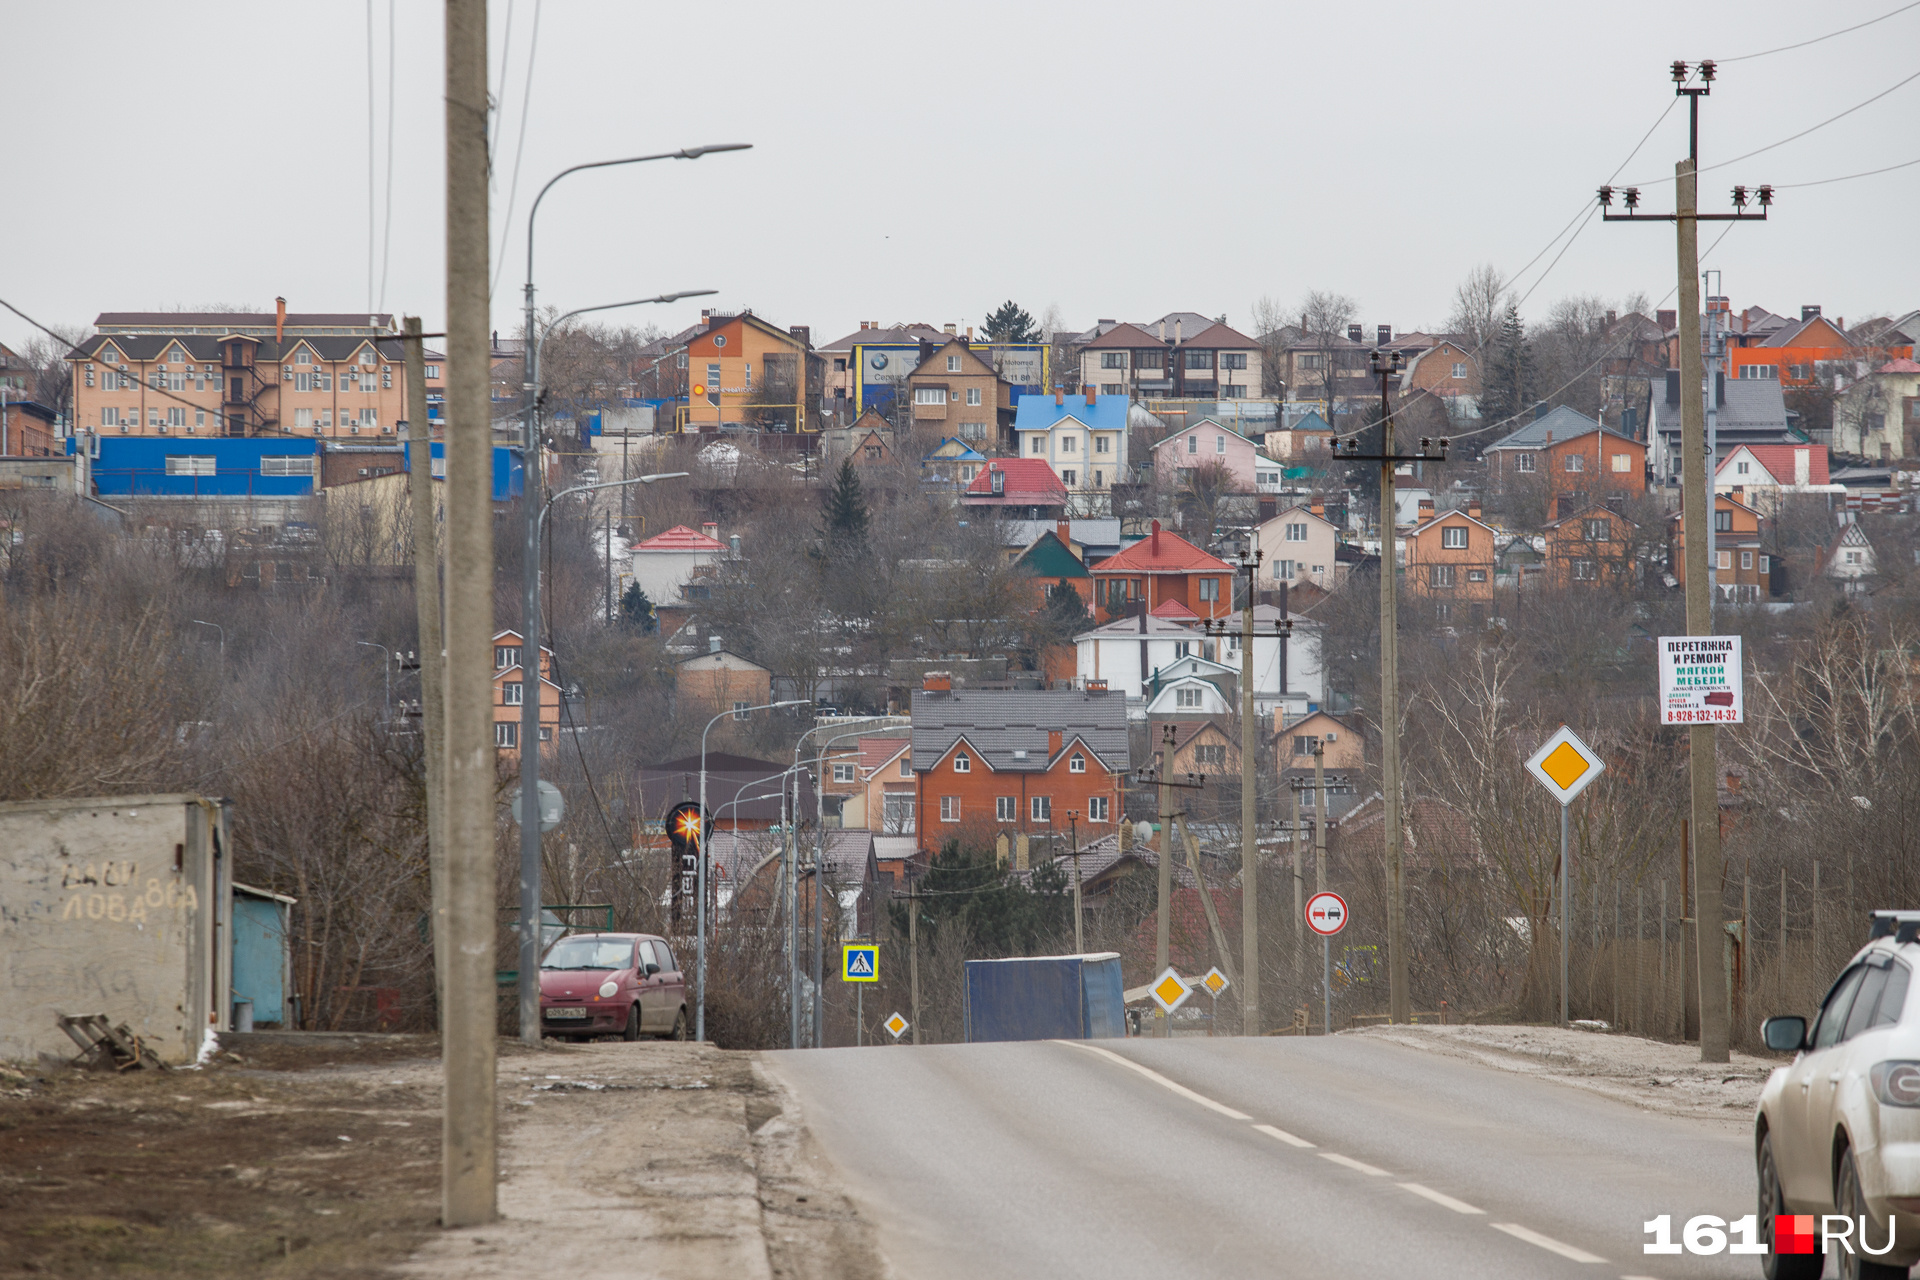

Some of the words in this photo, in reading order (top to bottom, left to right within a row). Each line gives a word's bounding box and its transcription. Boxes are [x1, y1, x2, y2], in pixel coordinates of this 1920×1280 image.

[1668, 640, 1733, 652] ПЕРЕТЯЖКА
[1673, 654, 1681, 664] И
[1683, 653, 1727, 664] РЕМОНТ
[1676, 665, 1724, 675] МЯГКОЙ
[1676, 676, 1725, 685] МЕБЕЛИ
[1667, 709, 1737, 722] 8-928-132-14-32
[62, 893, 147, 924] ЛОВА
